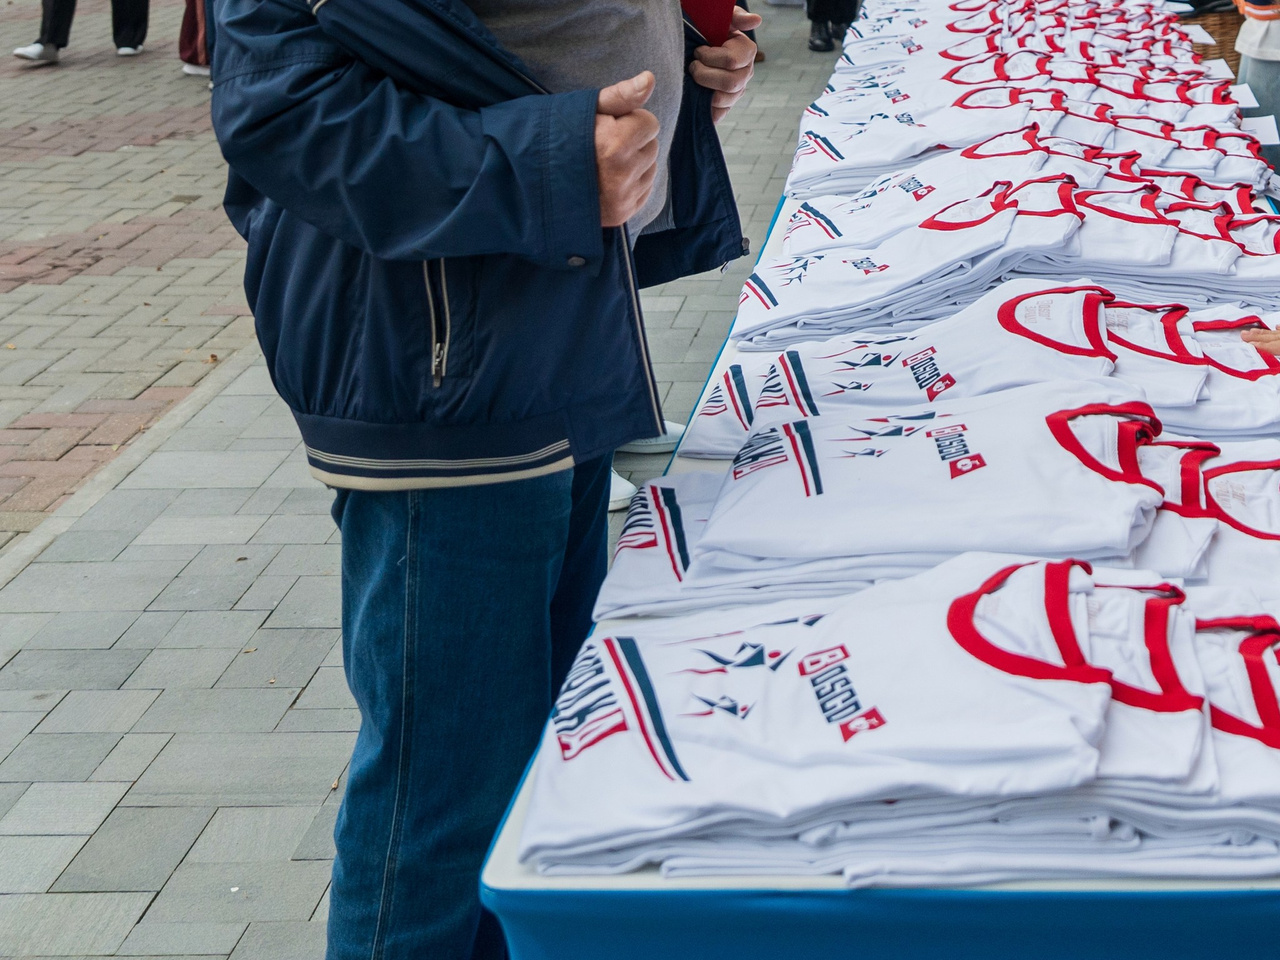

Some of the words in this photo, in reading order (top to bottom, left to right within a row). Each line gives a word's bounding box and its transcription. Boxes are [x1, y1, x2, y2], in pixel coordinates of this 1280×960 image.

[901, 345, 938, 390] BOSCO
[925, 423, 970, 462] BOSCO
[797, 643, 861, 724] BOSCO
